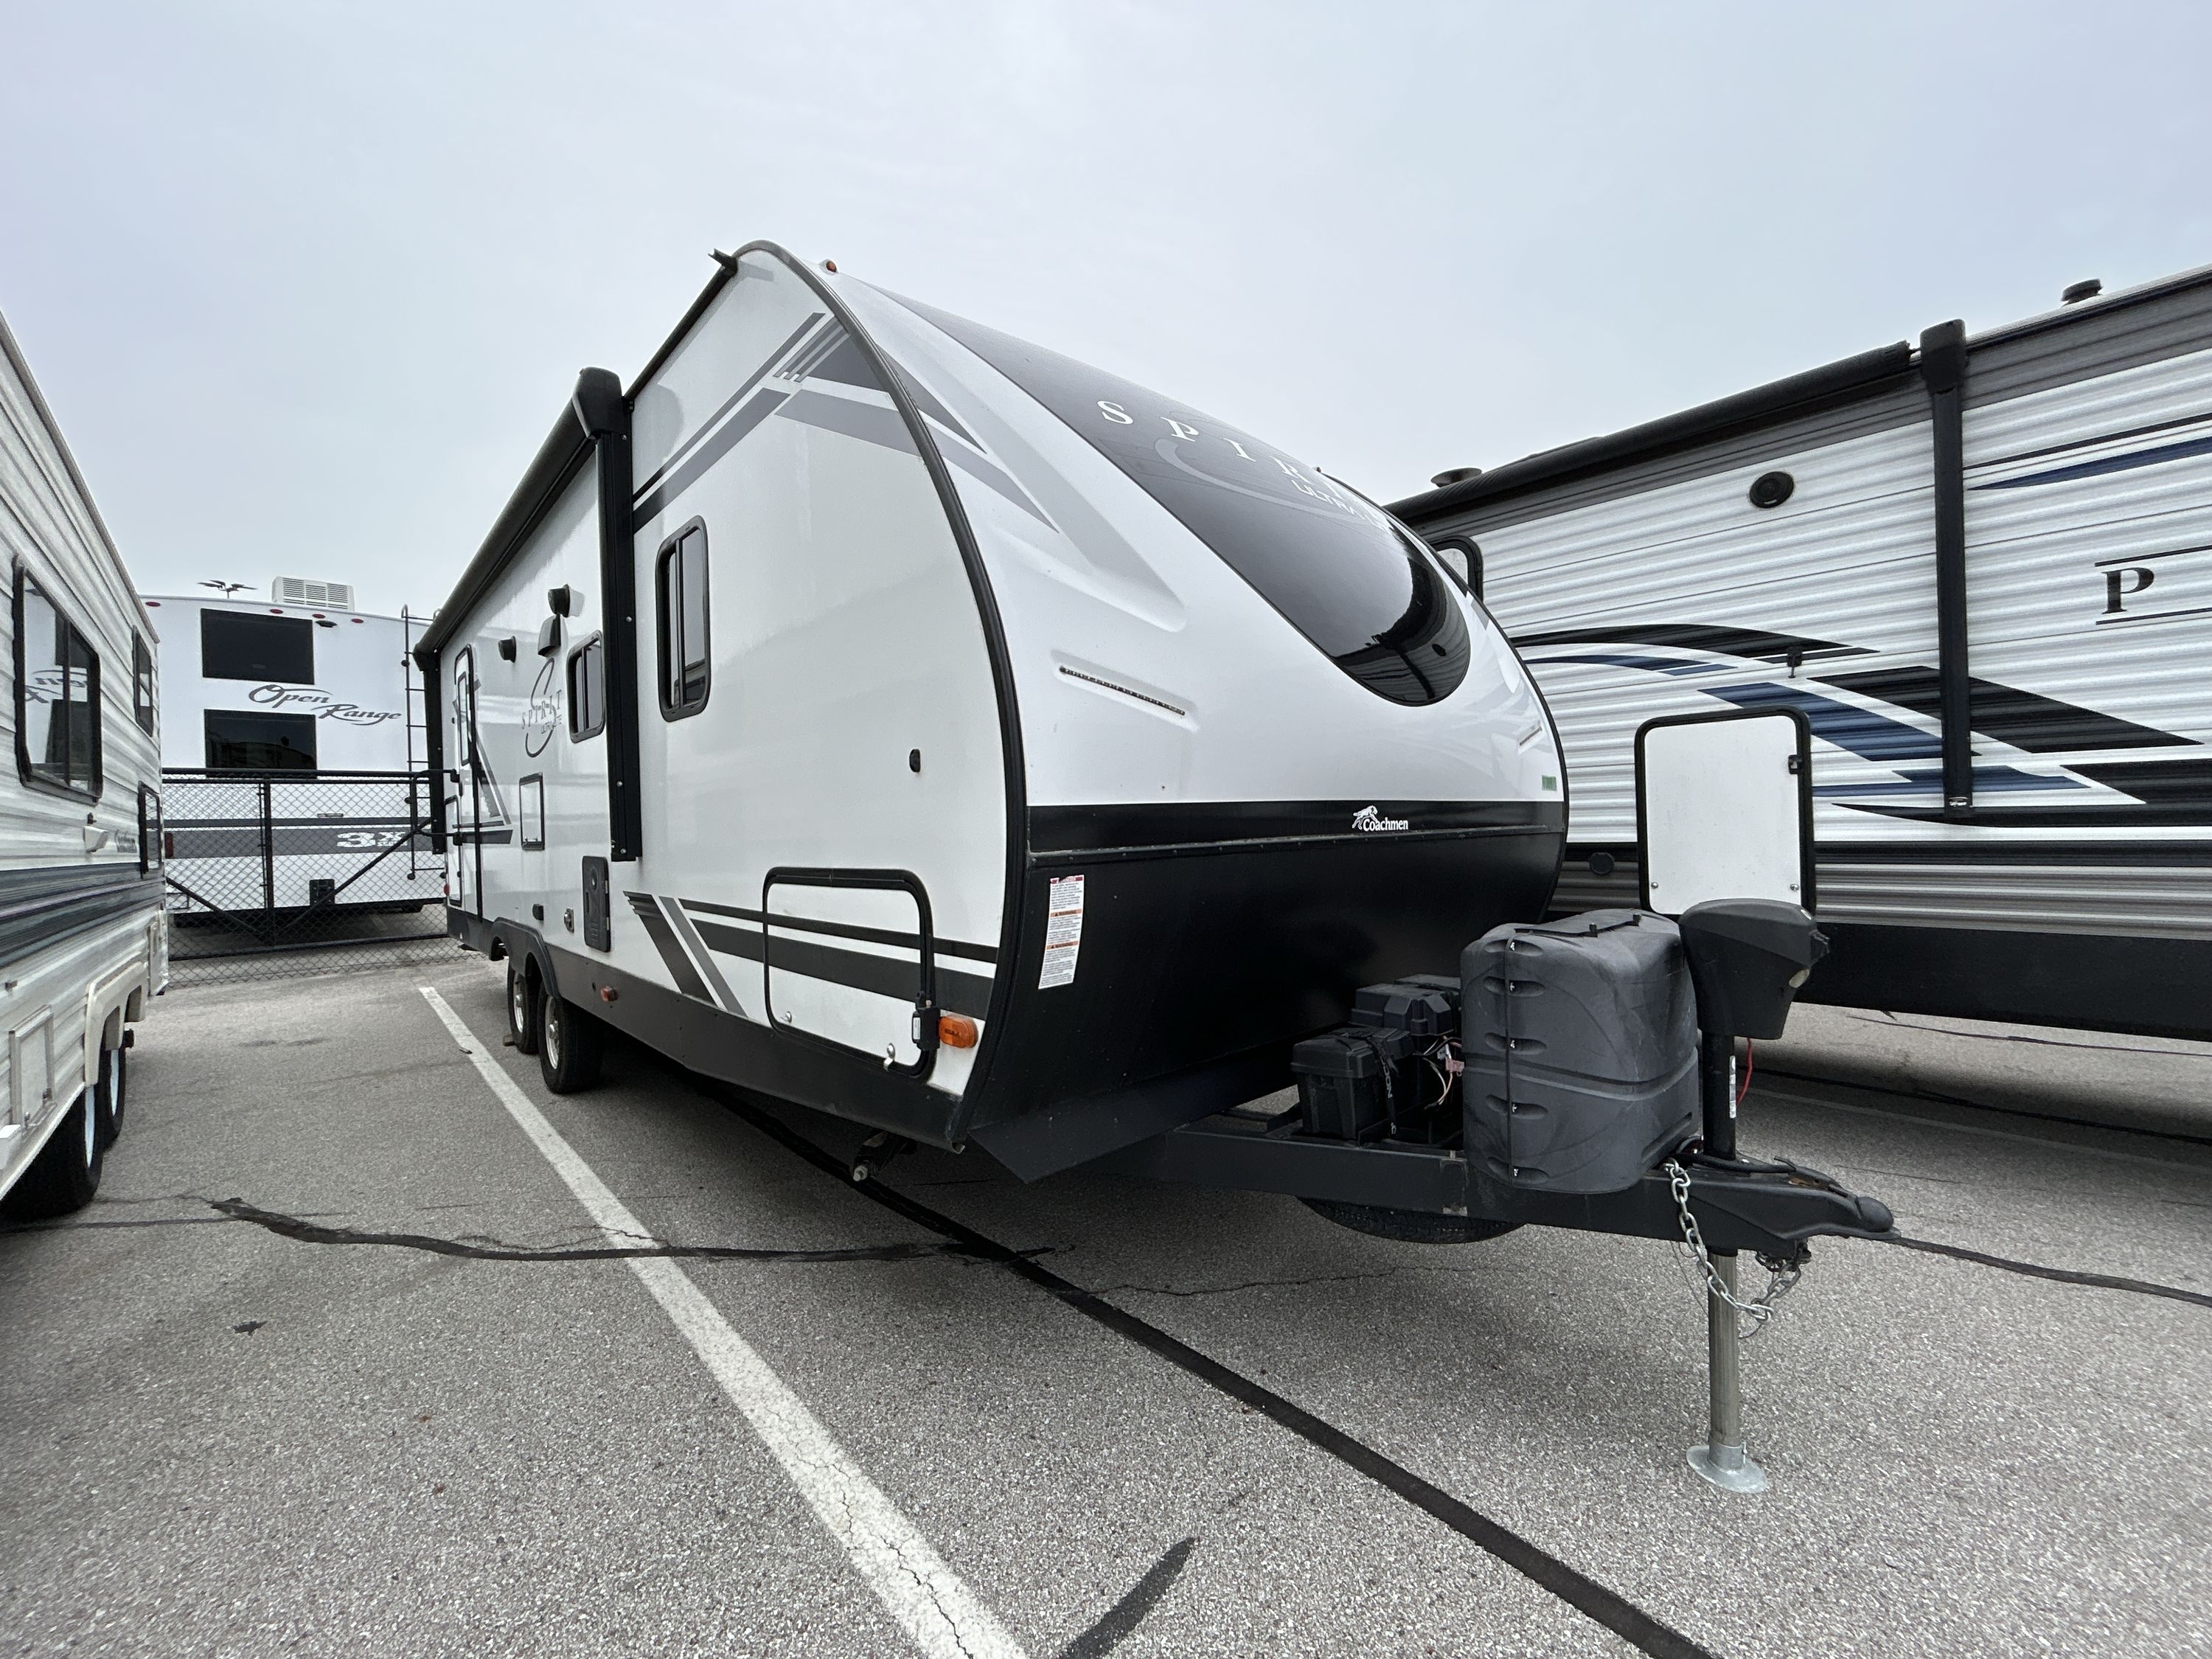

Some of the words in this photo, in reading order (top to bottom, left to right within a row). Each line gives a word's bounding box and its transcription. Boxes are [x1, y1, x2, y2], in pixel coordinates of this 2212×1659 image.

[248, 684, 333, 709] Open
[310, 703, 402, 726] Range
[521, 689, 562, 730] SPIRIT
[1363, 816, 1409, 832] Coachmen
